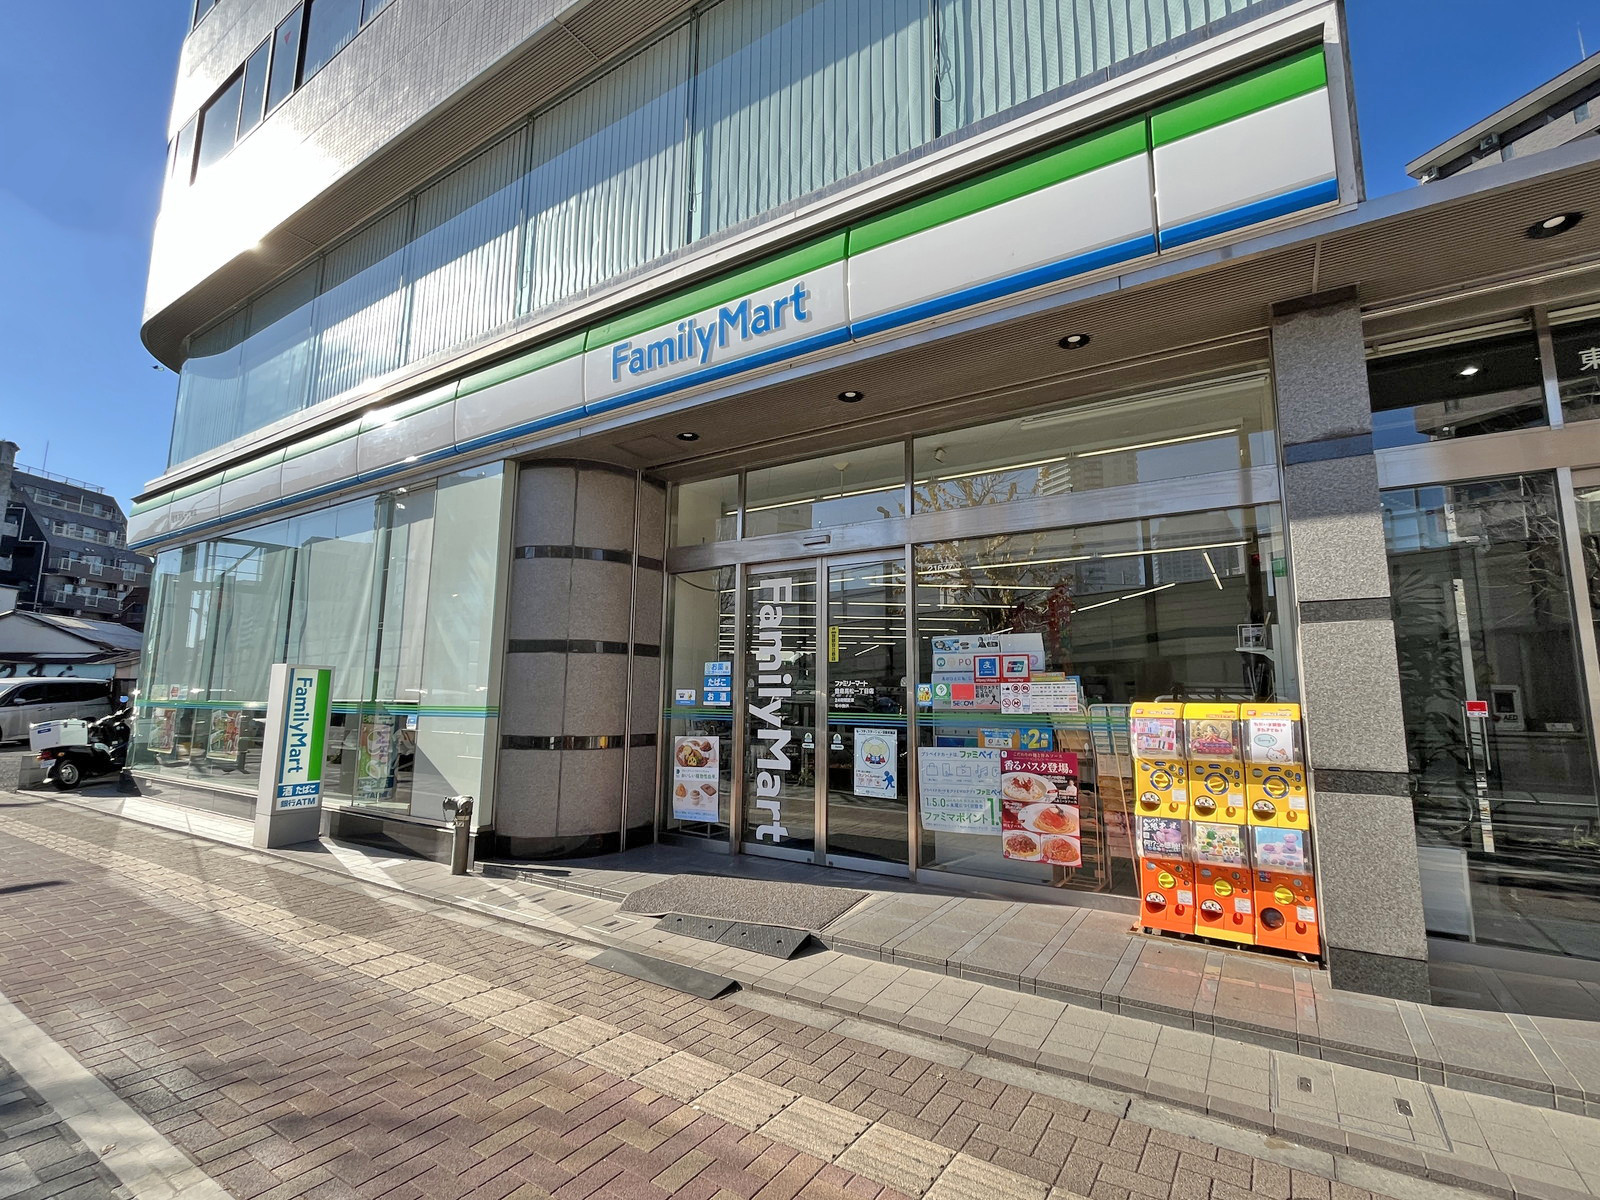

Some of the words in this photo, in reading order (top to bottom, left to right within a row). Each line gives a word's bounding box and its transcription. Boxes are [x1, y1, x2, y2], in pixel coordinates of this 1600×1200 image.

[612, 281, 808, 382] FamilyMart
[707, 678, 727, 687] たばこ
[748, 577, 793, 844] FamilyMart
[287, 677, 314, 774] FamilyMart
[959, 750, 993, 760] ファミペイ
[1004, 759, 1073, 774] 香るパスタ登場。
[282, 785, 293, 797] 酒
[295, 784, 316, 796] たばこ
[280, 797, 316, 808] 銀行ATM
[924, 811, 989, 825] ファミマポイント
